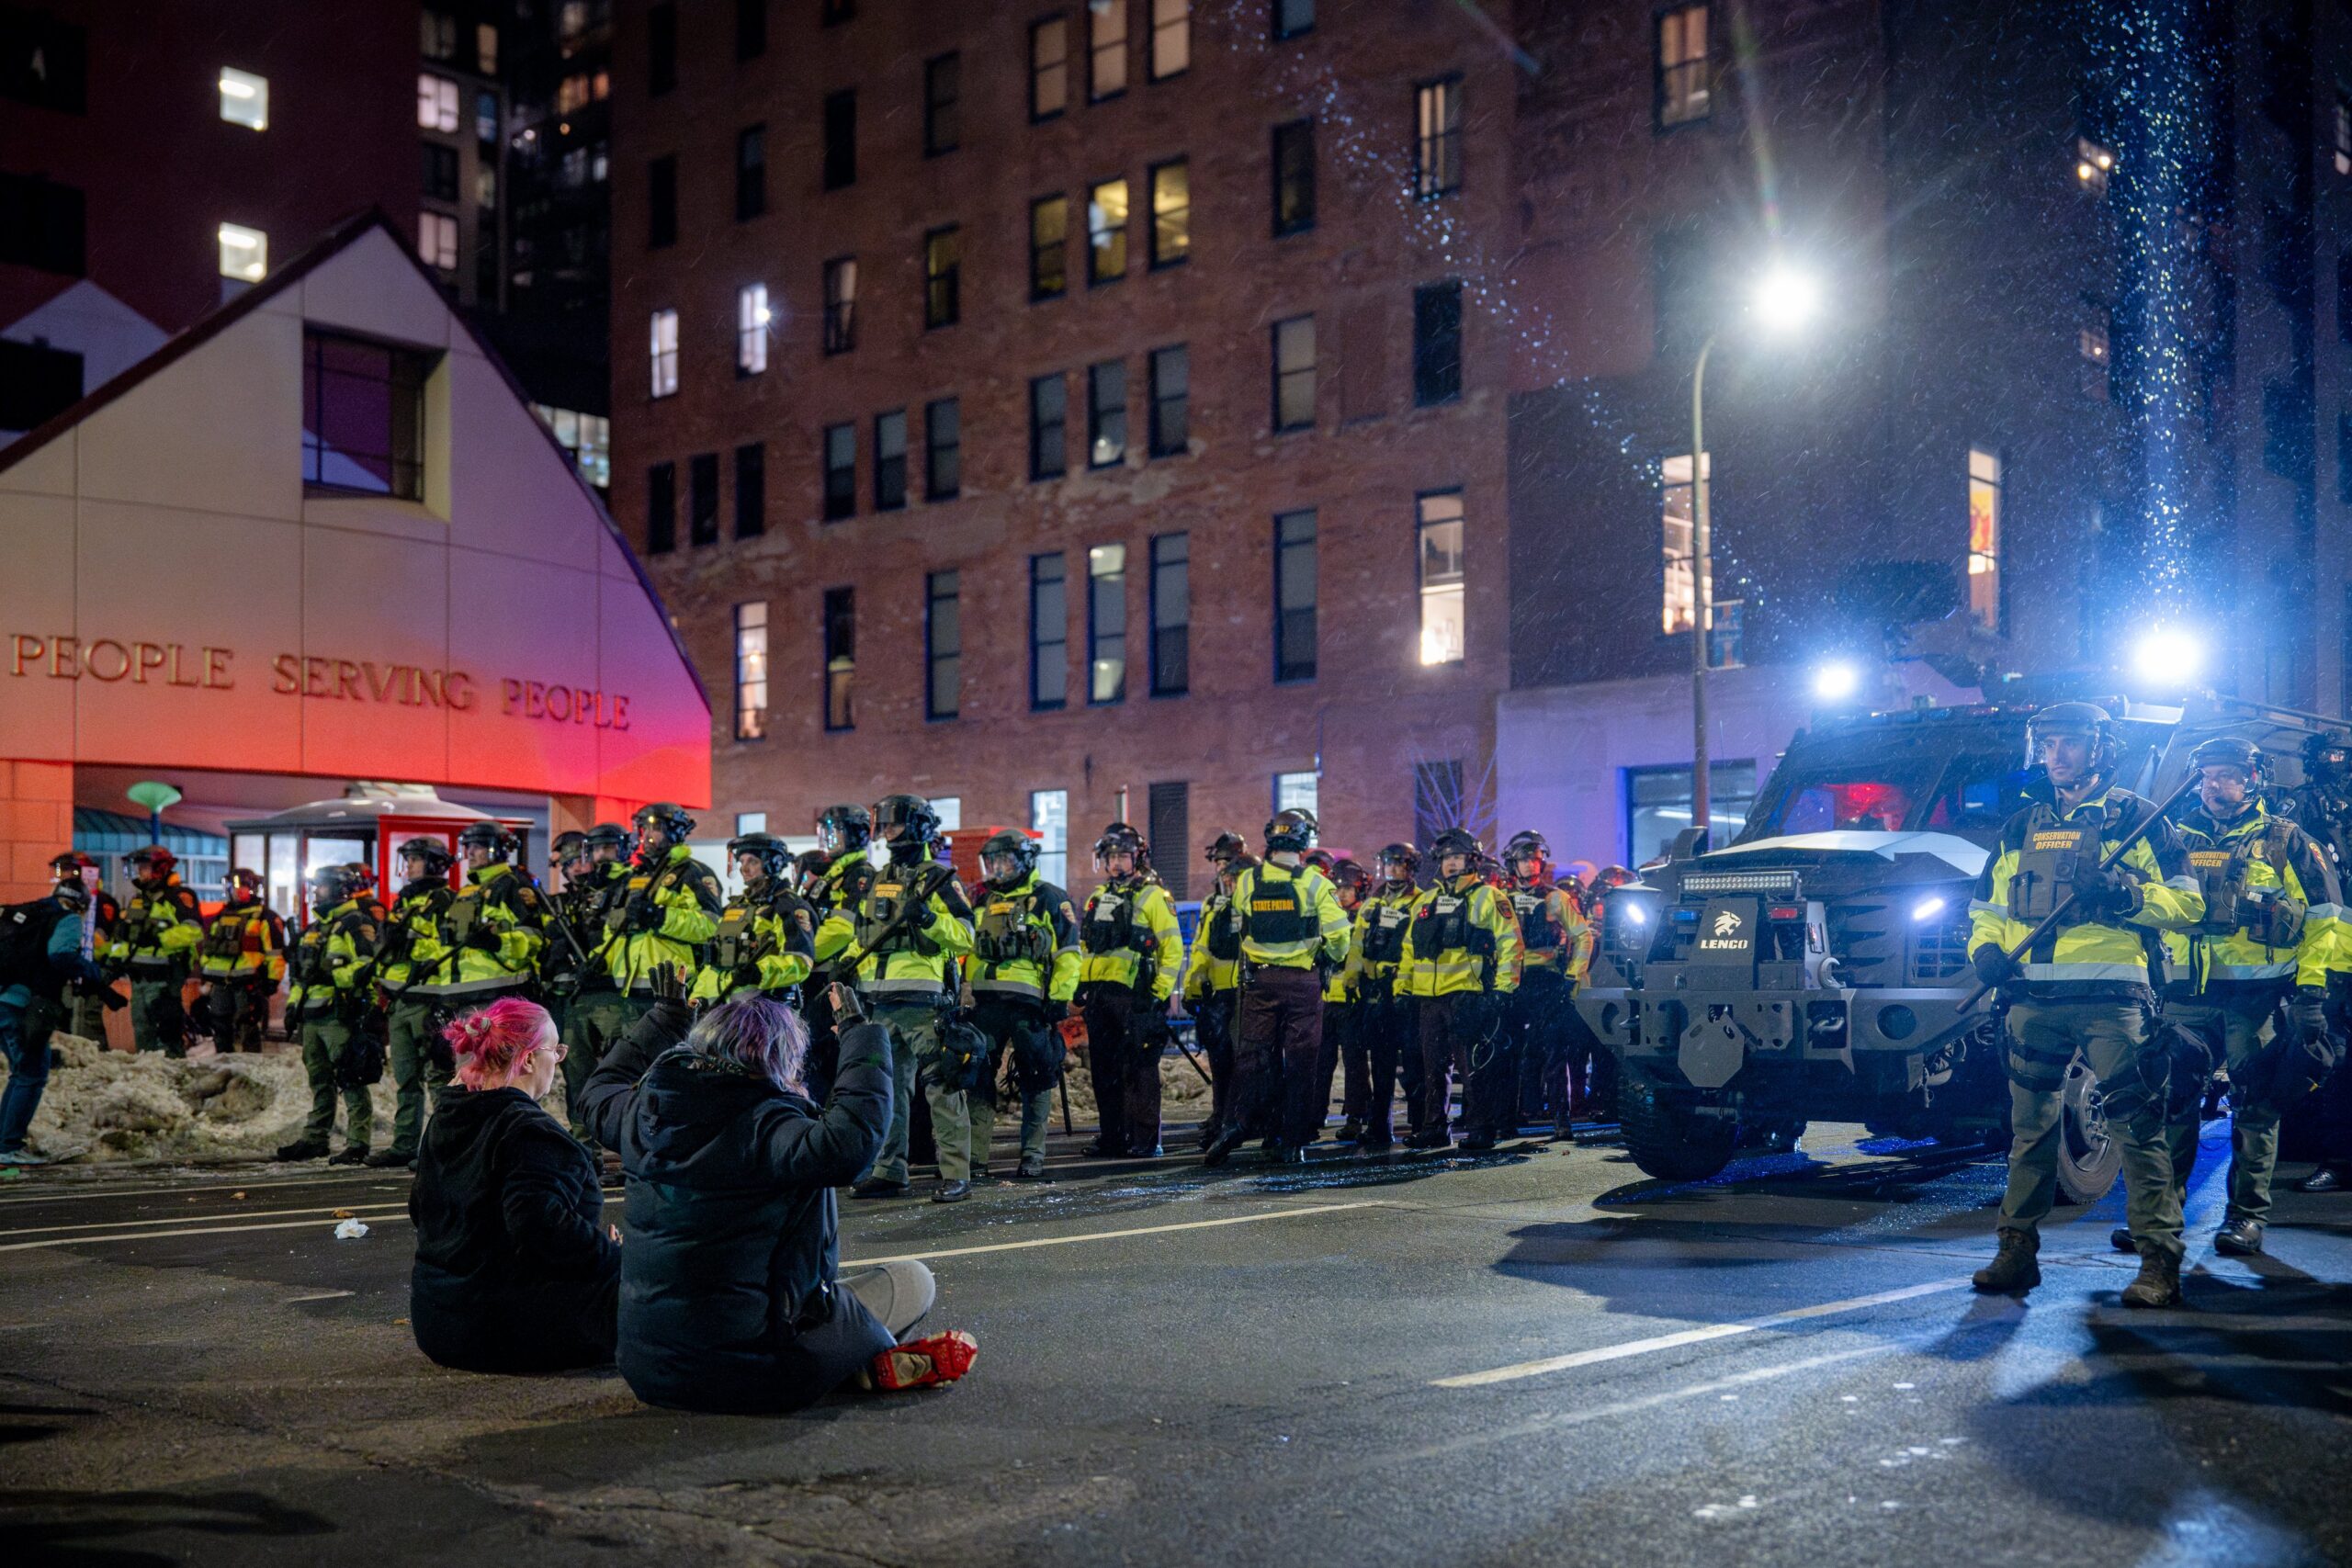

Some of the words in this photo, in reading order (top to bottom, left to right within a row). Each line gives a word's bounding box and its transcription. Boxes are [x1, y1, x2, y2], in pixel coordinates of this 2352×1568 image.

[9, 633, 234, 690] PEOPLE
[273, 653, 473, 711] SERVING
[500, 677, 629, 731] PEOPLE
[2033, 830, 2081, 841] CONSERVATION
[2035, 840, 2073, 851] OFFICER
[1252, 900, 1272, 911] STATE
[1272, 899, 1295, 910] PATROL
[1701, 939, 1748, 950] LENCO
